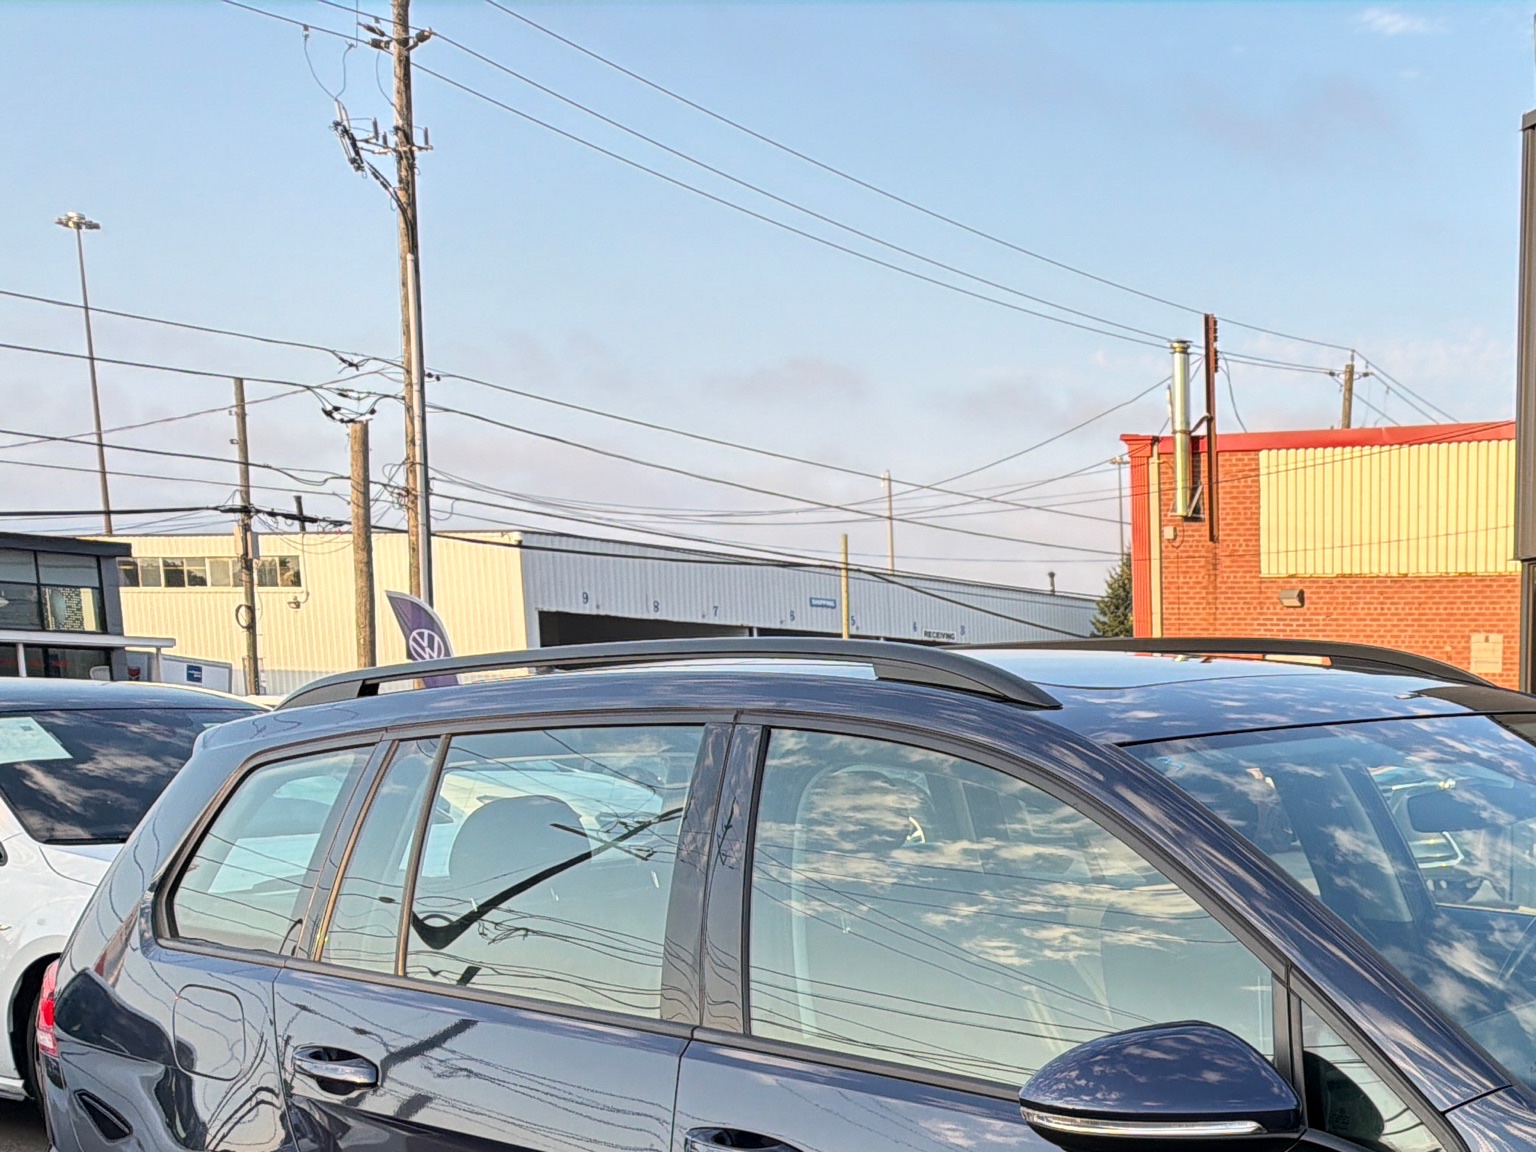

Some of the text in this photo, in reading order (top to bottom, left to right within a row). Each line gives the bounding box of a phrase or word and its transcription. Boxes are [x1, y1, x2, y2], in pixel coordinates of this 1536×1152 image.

[582, 591, 589, 604] 9
[653, 600, 660, 612] 8
[712, 605, 719, 617] 7
[850, 615, 856, 626] 5
[923, 630, 955, 640] RECEIVING
